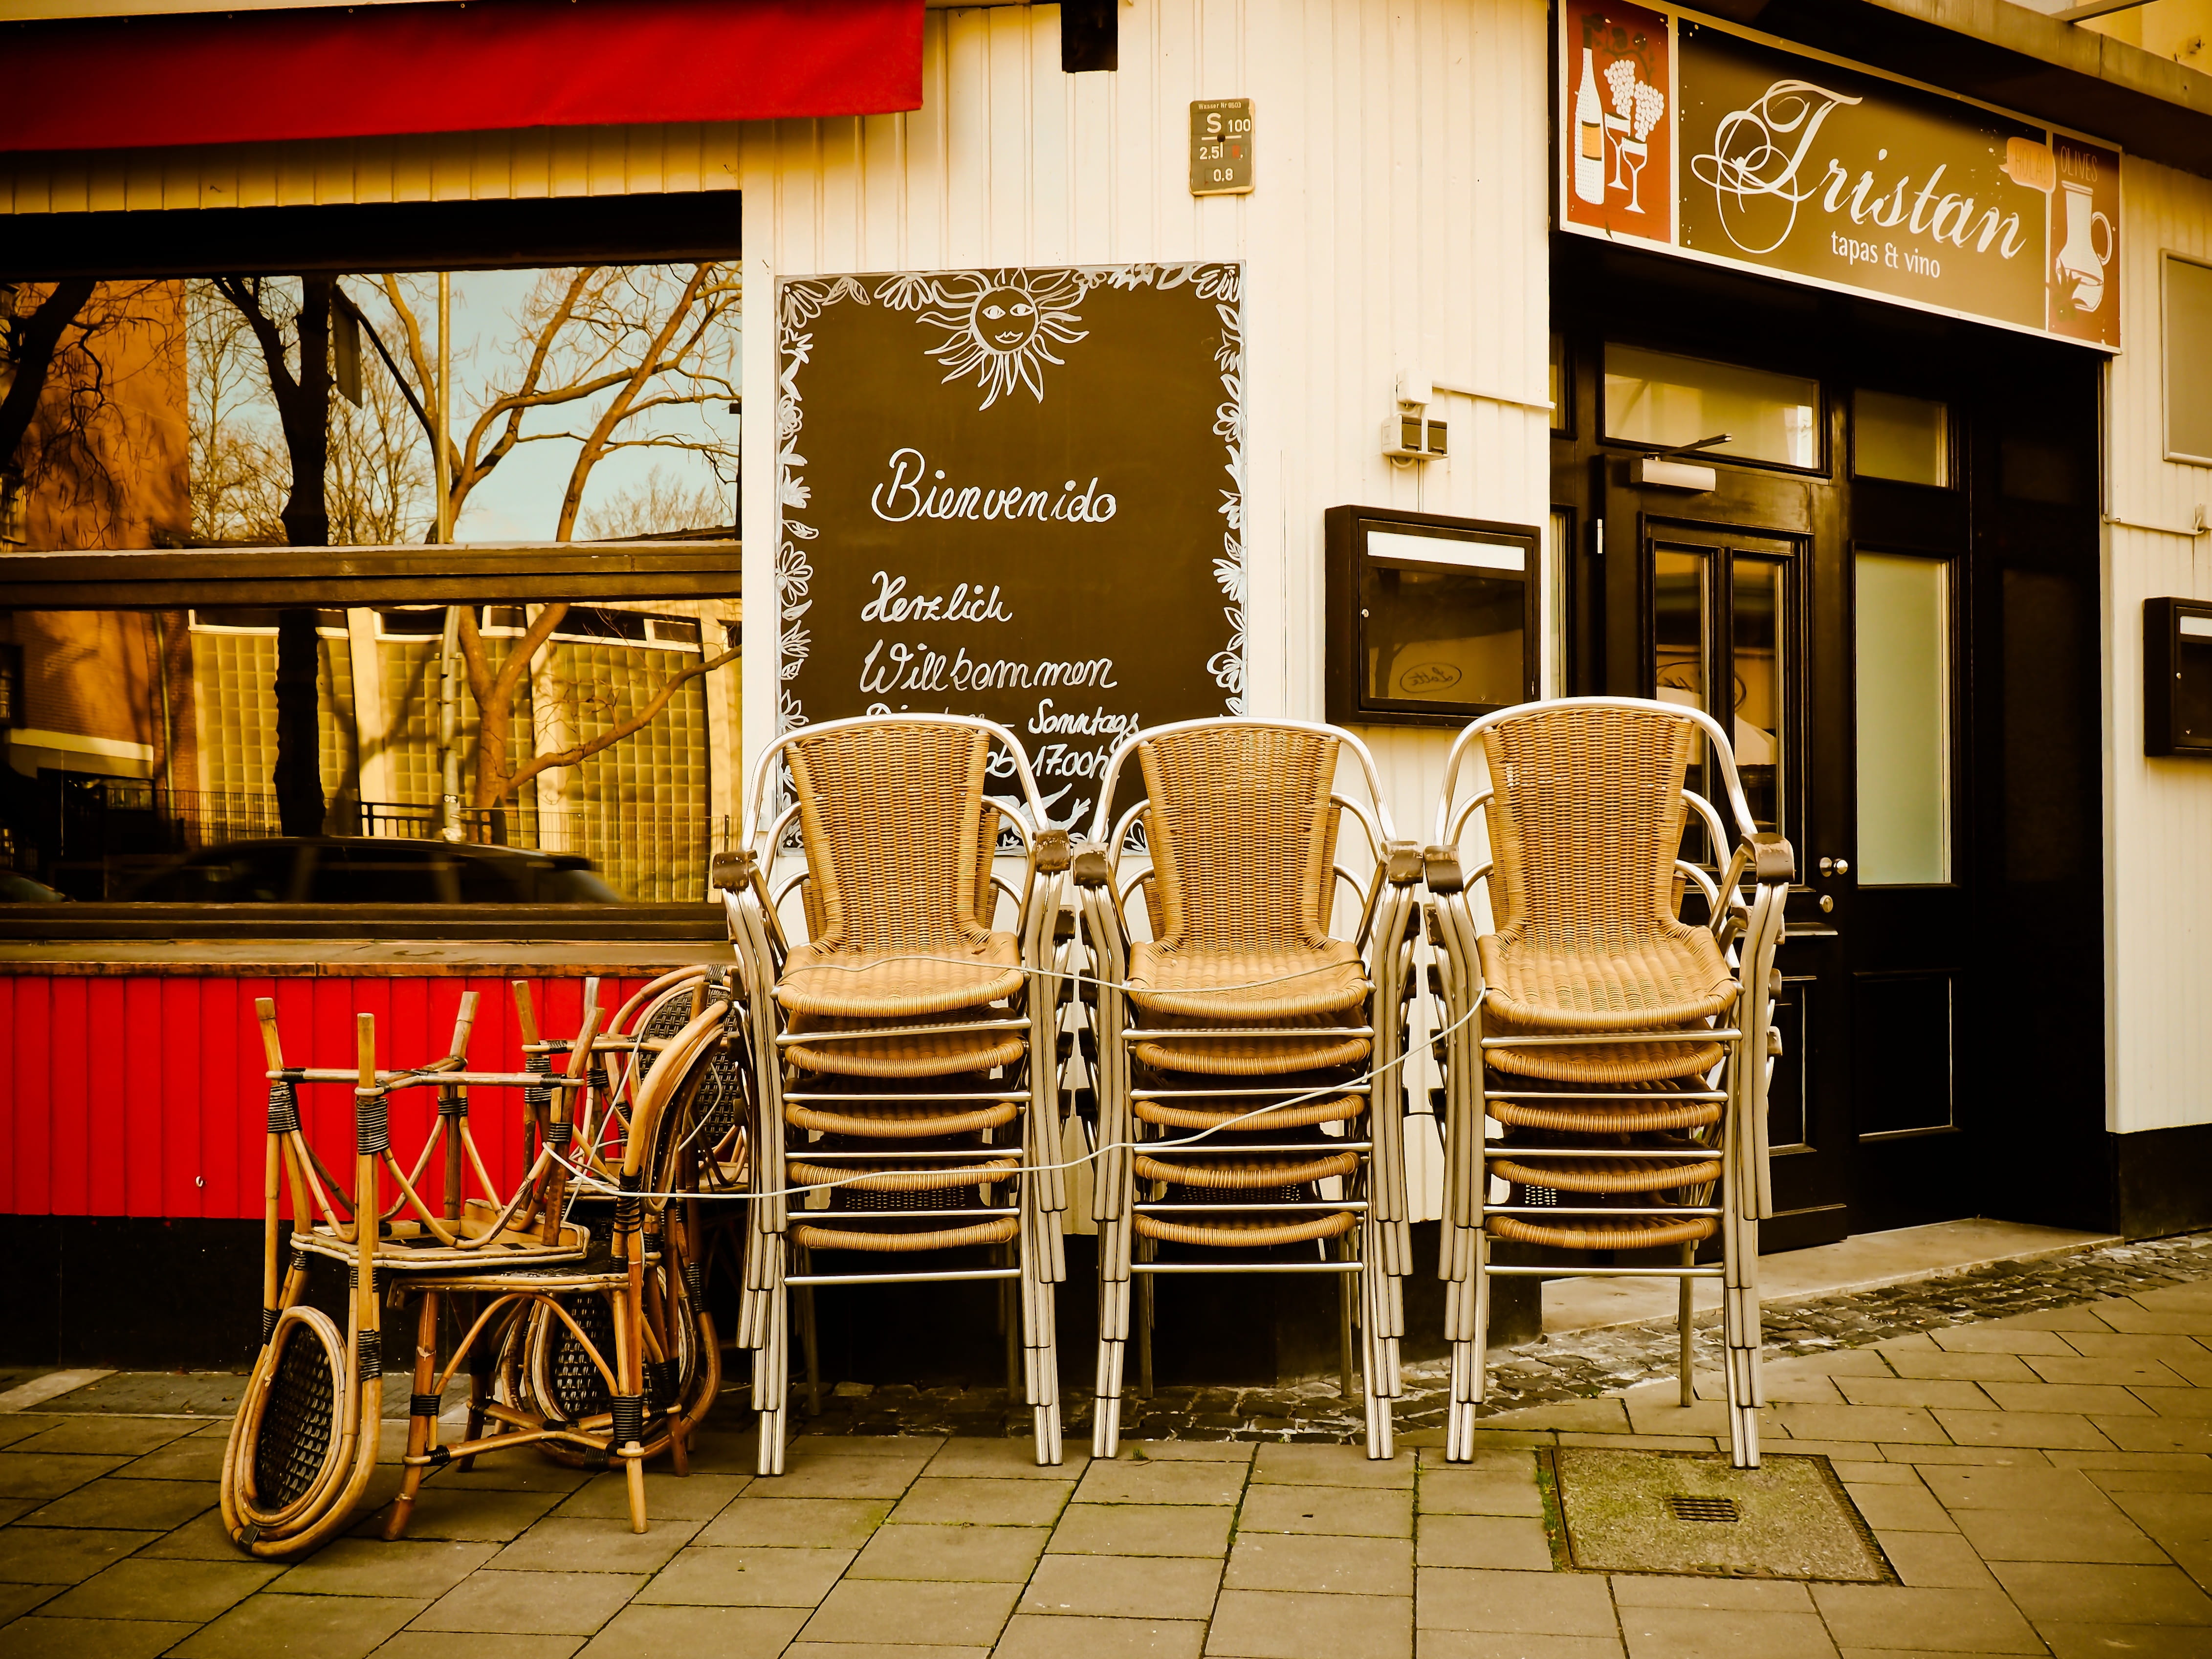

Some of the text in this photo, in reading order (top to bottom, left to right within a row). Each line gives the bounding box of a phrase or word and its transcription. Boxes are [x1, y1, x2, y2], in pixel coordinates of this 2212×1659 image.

[1206, 112, 1251, 133] S 100
[1691, 79, 2027, 260] Tristan
[2015, 146, 2046, 184] HOLA!
[2060, 145, 2098, 182] OLIVES
[1831, 231, 1941, 278] tapas & vino
[871, 447, 1117, 523] Bienvenido
[861, 570, 1013, 622] Herzlich
[859, 639, 1117, 694] Willkommen
[1028, 698, 1139, 754] Sonntags
